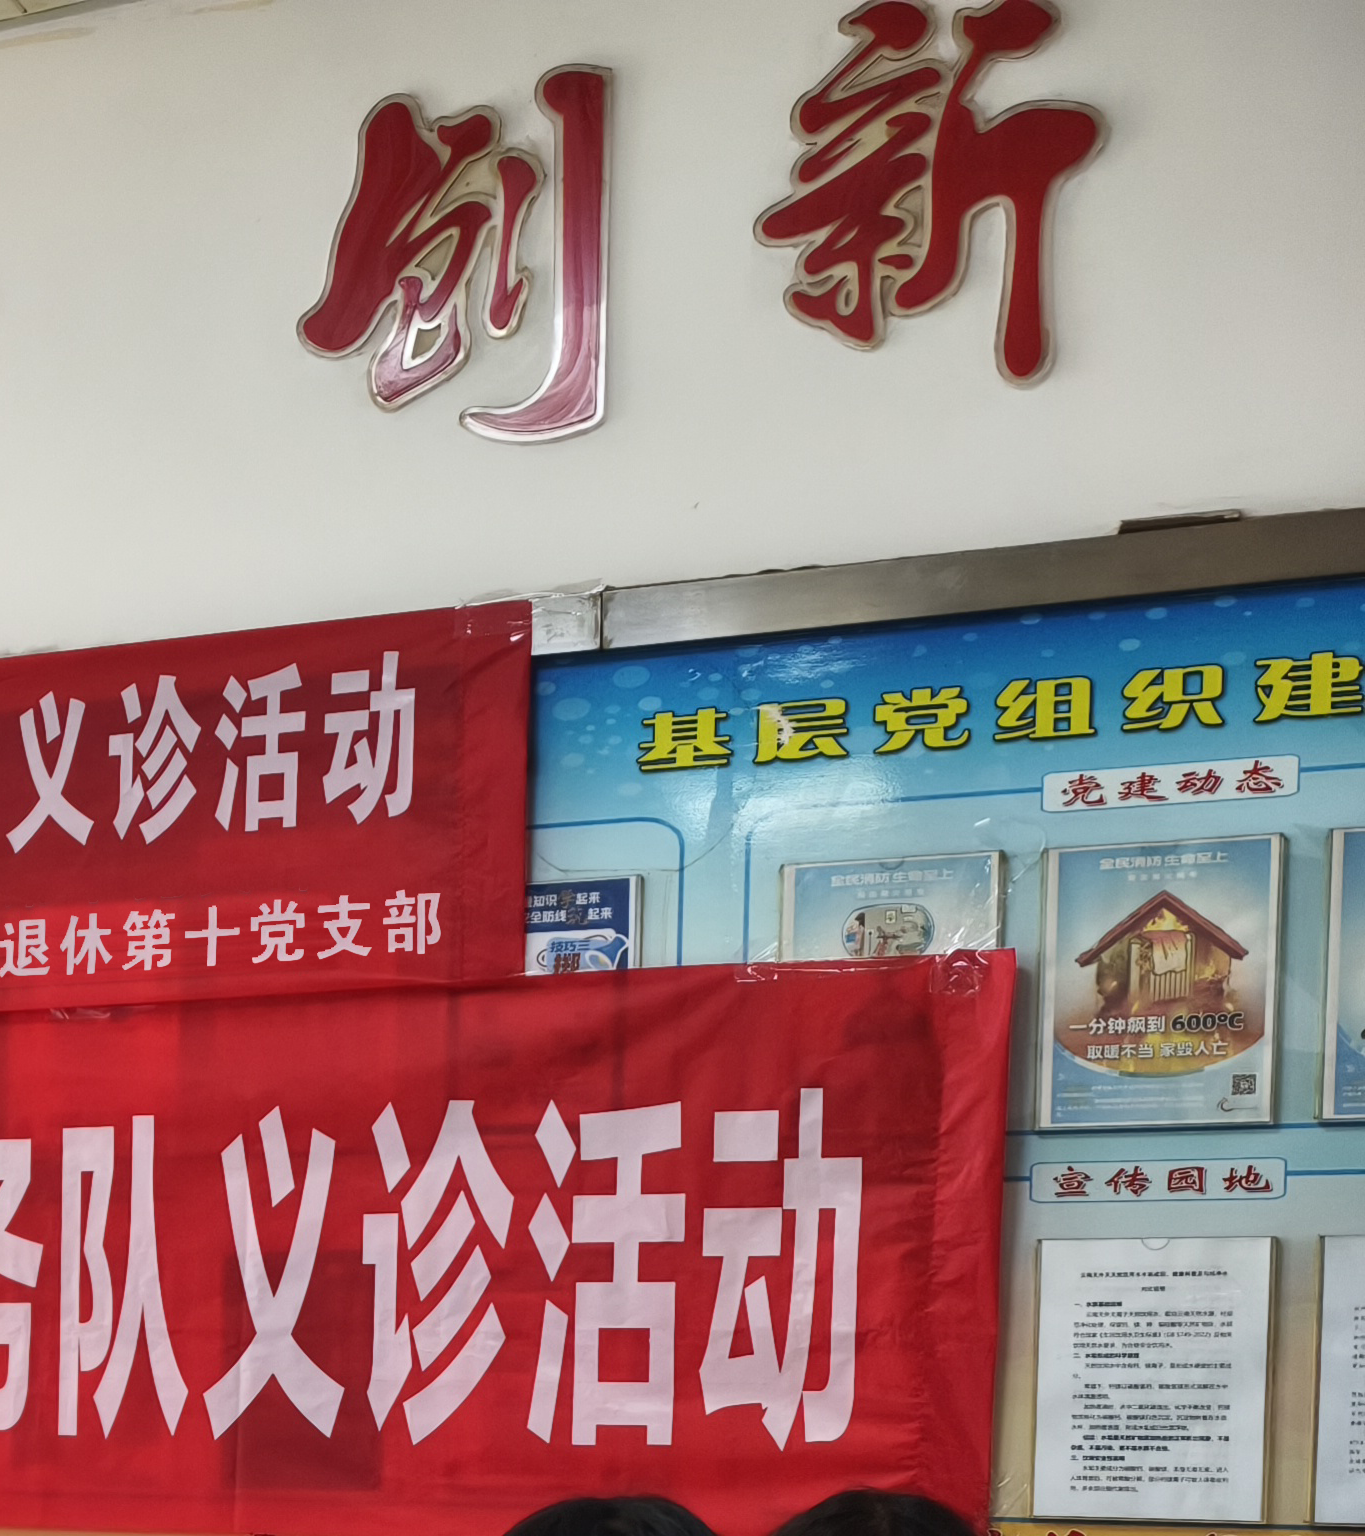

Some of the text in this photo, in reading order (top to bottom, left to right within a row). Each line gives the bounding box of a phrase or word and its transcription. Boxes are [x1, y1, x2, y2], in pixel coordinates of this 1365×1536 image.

[637, 651, 1365, 773] 基层党组织建
[1061, 760, 1285, 807] 党建动态
[527, 889, 601, 909] 知识学起来
[1069, 1015, 1166, 1035] 一分钟飙到
[1086, 1041, 1229, 1060] 取暖不当 家毁人亡
[1052, 1165, 1274, 1198] 宣传园地
